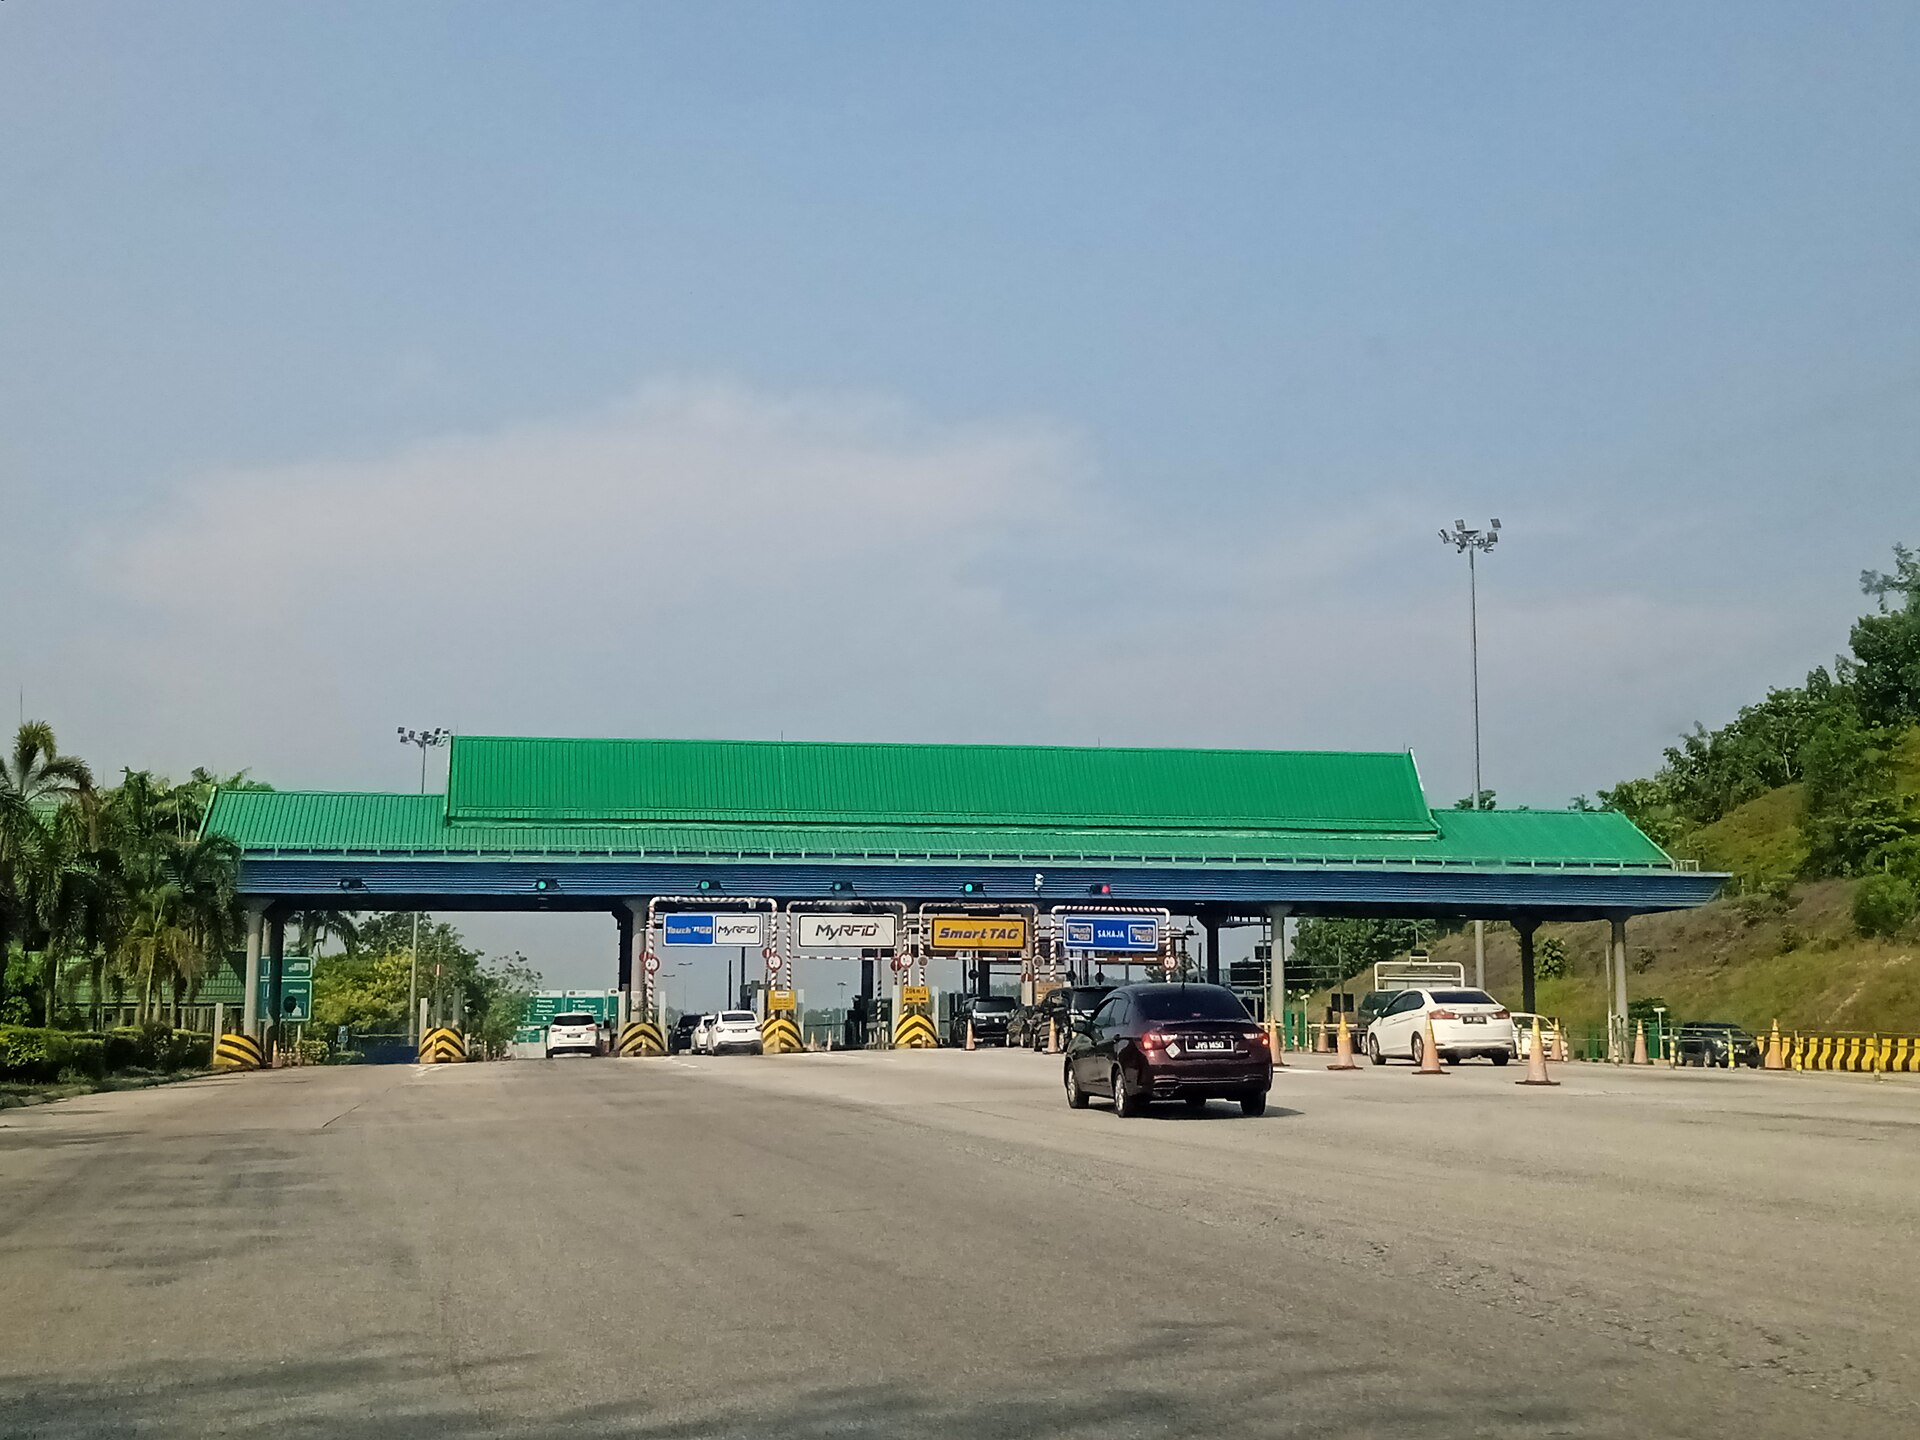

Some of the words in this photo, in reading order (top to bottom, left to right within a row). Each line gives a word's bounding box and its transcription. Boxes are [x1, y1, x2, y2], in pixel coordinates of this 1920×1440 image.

[667, 926, 691, 934] Touch
[938, 927, 988, 939] Smart
[989, 928, 1019, 939] TAG
[1069, 926, 1091, 934] Touch
[1097, 929, 1125, 938] SAHAJA
[1131, 927, 1153, 935] Touch
